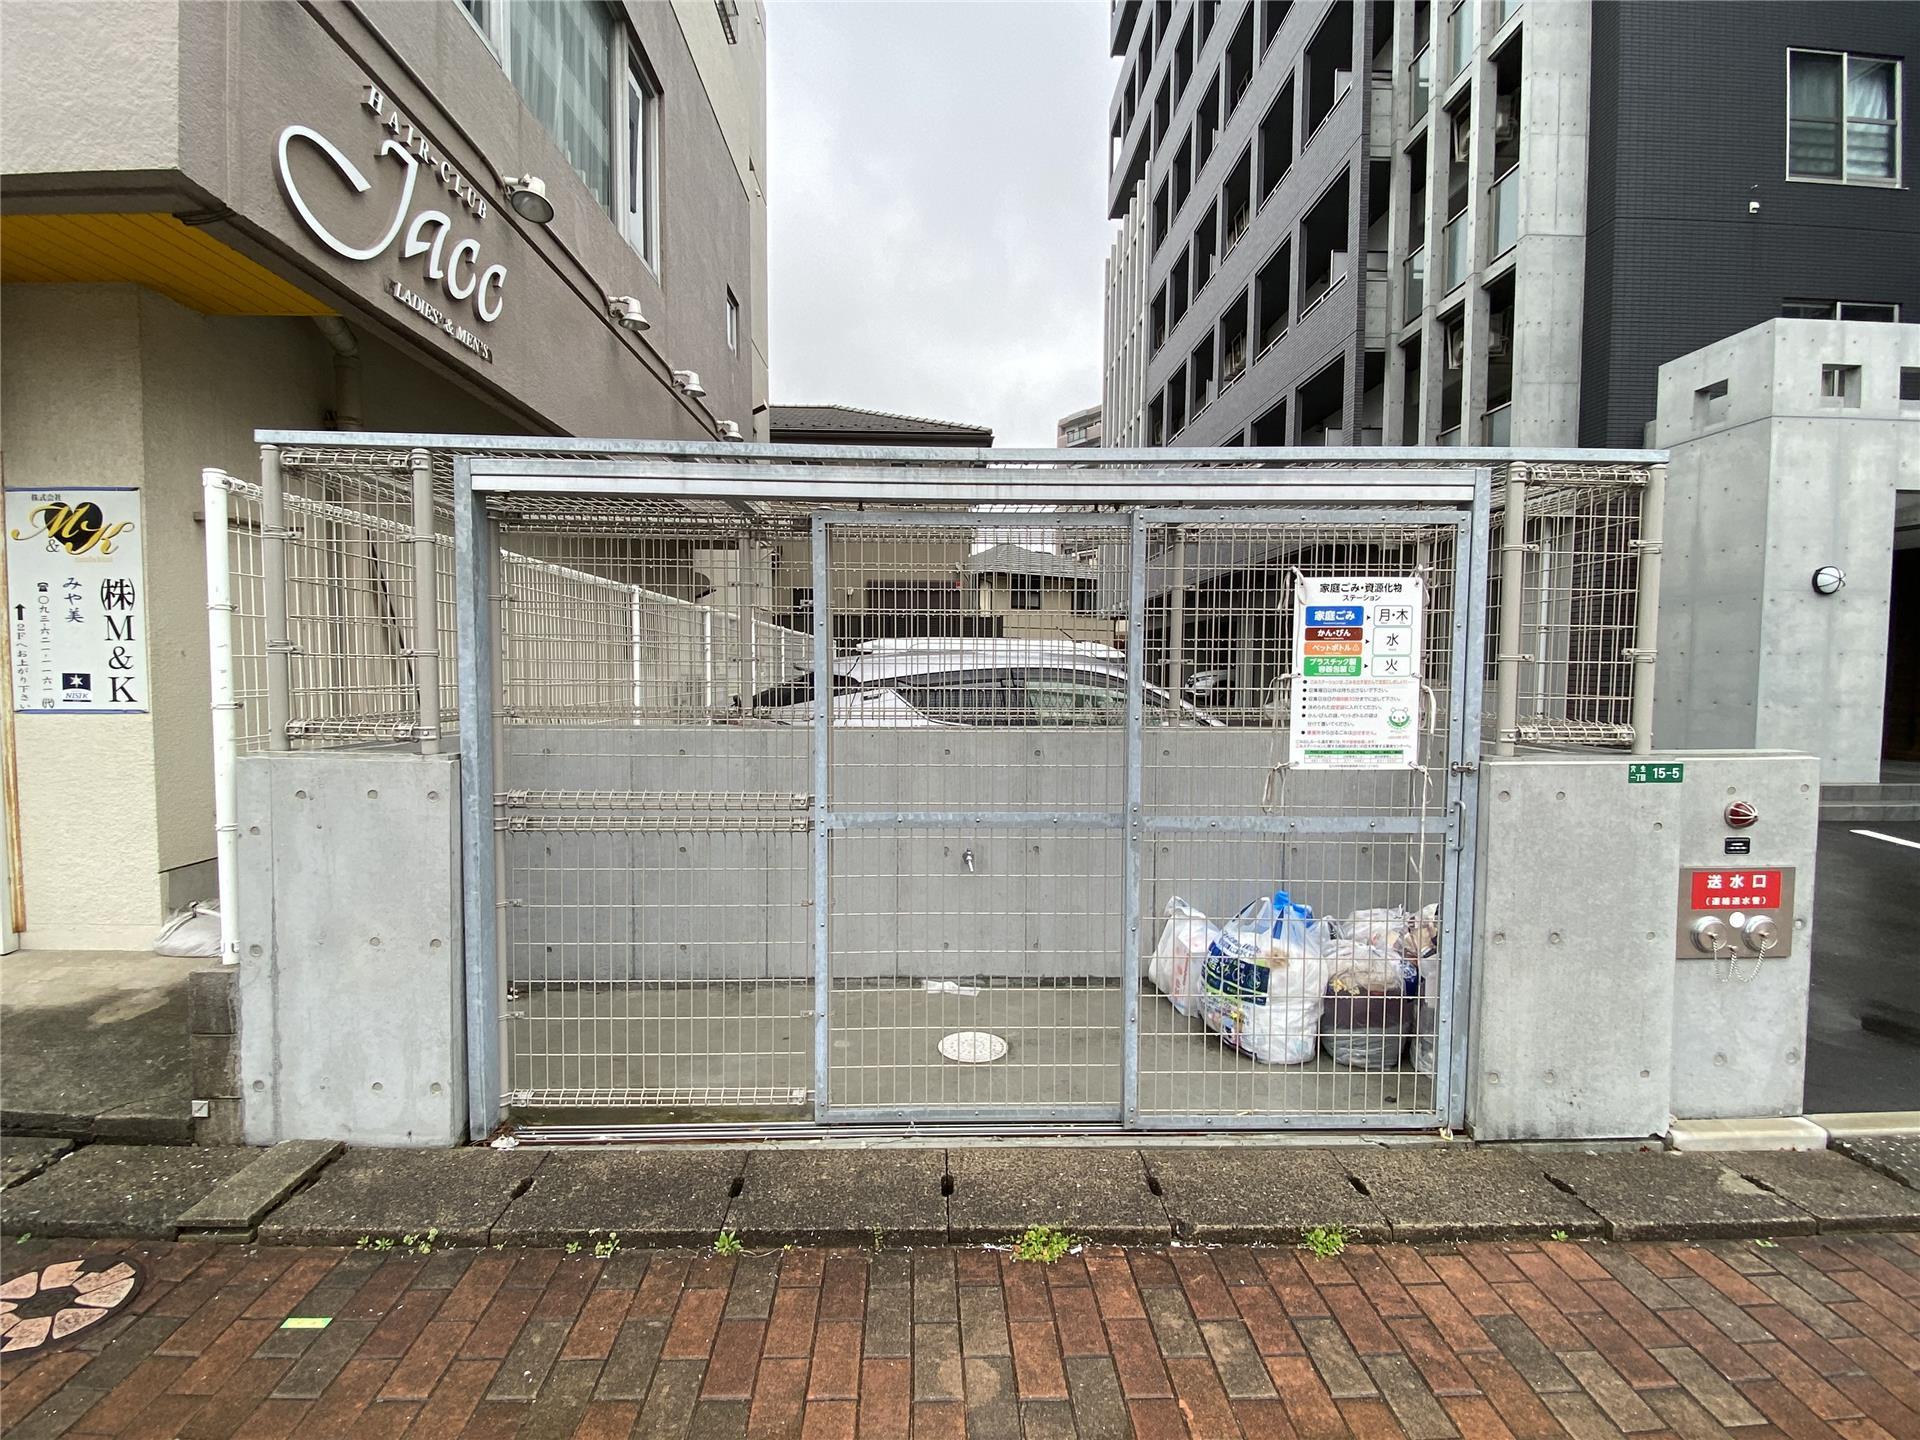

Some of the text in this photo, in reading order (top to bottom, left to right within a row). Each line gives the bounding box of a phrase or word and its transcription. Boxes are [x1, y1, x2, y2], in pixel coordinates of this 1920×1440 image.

[367, 85, 487, 219] HAIR-CLUB
[443, 318, 455, 336] &
[455, 326, 489, 360] MEN'S
[1319, 583, 1403, 593] 家庭ごみ・資源化物
[62, 577, 85, 624] みや美
[1342, 594, 1381, 602] ステーション
[1314, 609, 1355, 621] 家庭ごみ
[1379, 608, 1409, 622] 月・木
[1317, 629, 1351, 638] かん・びん
[1386, 632, 1399, 647] 水
[1385, 658, 1398, 672] 火
[1652, 767, 1680, 779] 15-5
[1707, 874, 1767, 889] 送水口
